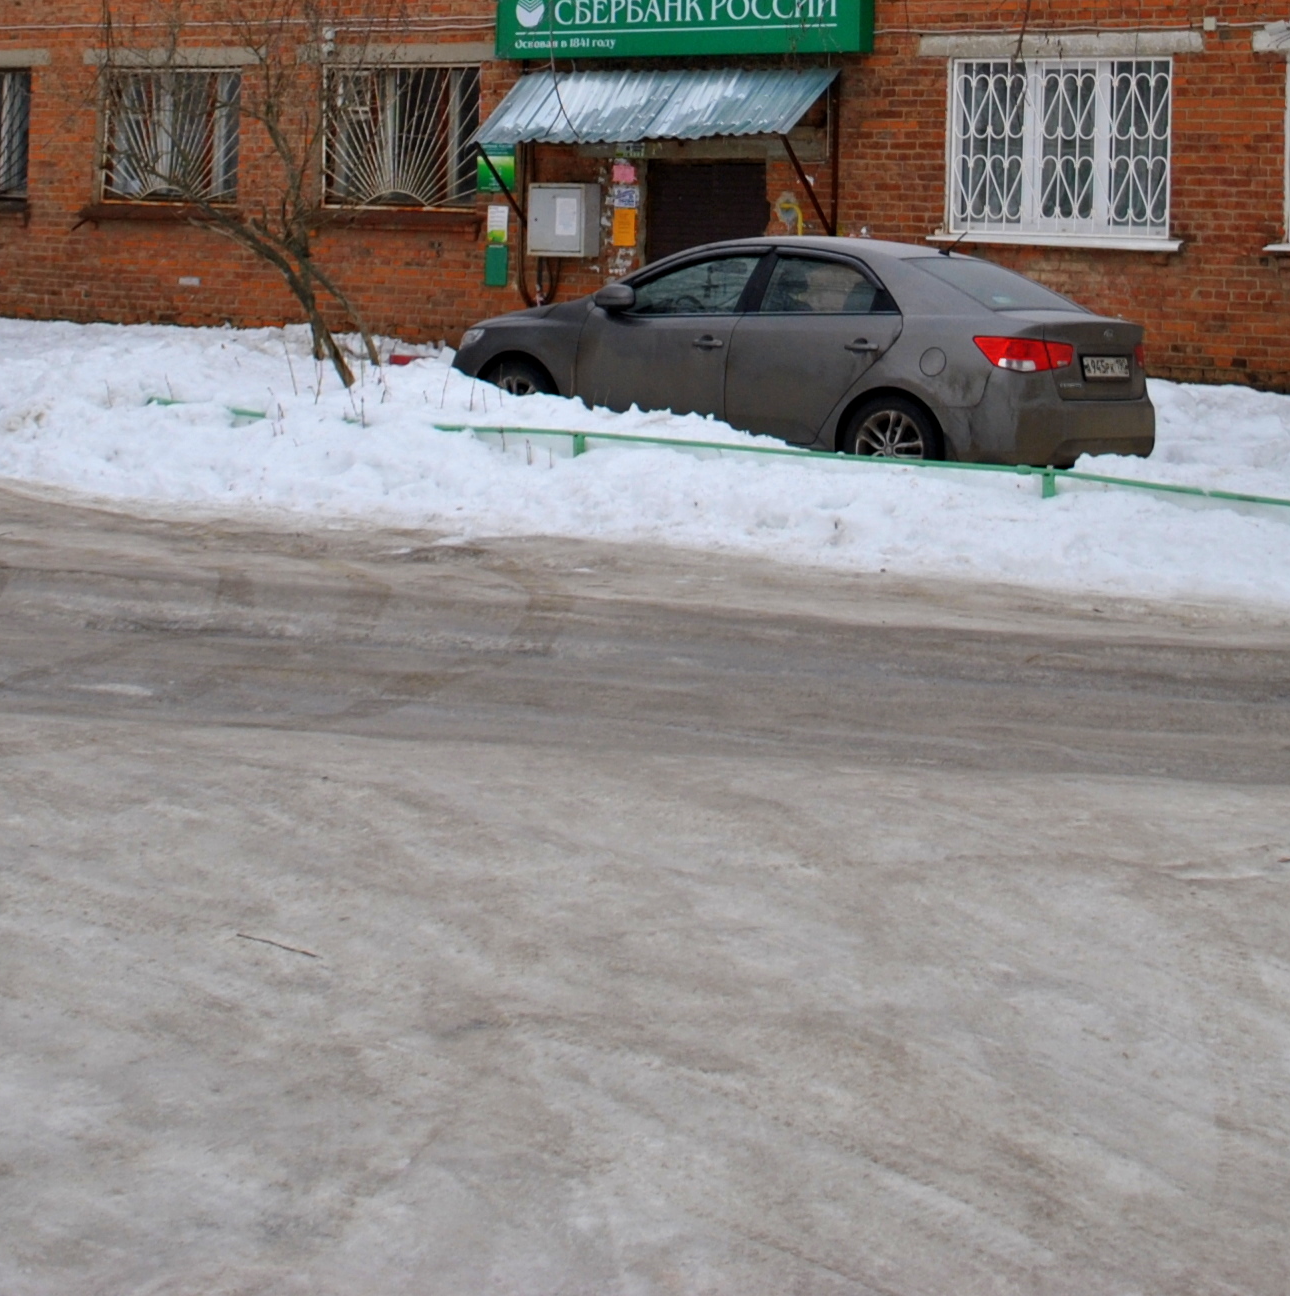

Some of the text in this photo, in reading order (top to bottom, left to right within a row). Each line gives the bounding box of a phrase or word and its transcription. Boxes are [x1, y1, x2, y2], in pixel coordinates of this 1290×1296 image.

[560, 39, 568, 48] в
[569, 37, 590, 49] 1841
[591, 37, 617, 50] году
